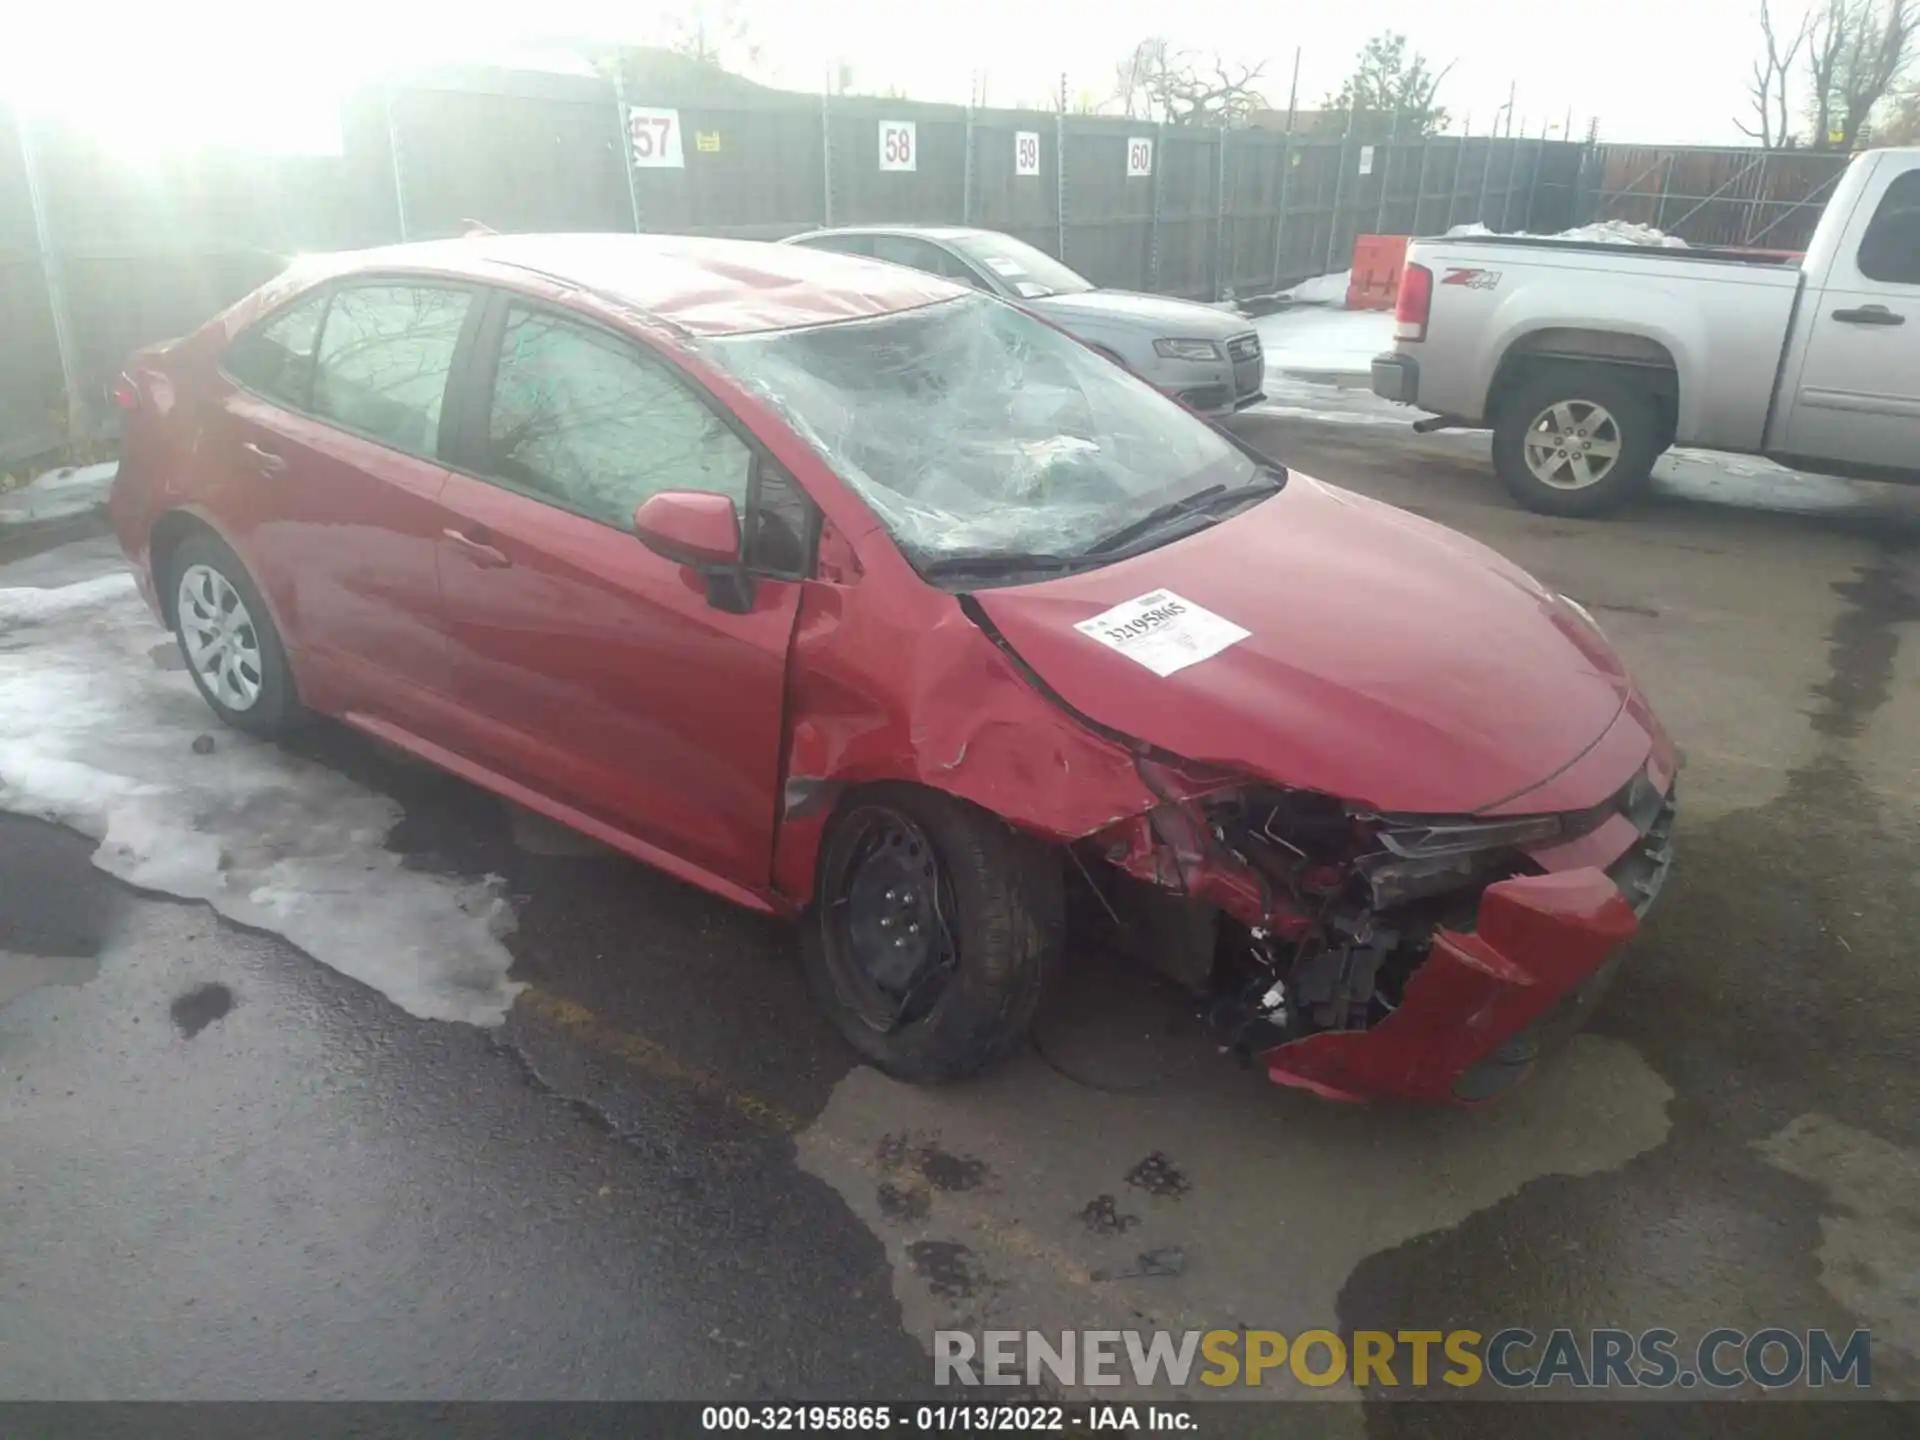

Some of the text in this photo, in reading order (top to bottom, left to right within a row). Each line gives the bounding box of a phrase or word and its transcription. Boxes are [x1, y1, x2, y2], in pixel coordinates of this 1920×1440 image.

[633, 117, 671, 158] 57
[885, 128, 911, 163] 58
[1019, 139, 1036, 169] 59
[1131, 143, 1150, 171] 60
[1104, 601, 1187, 642] 32195865
